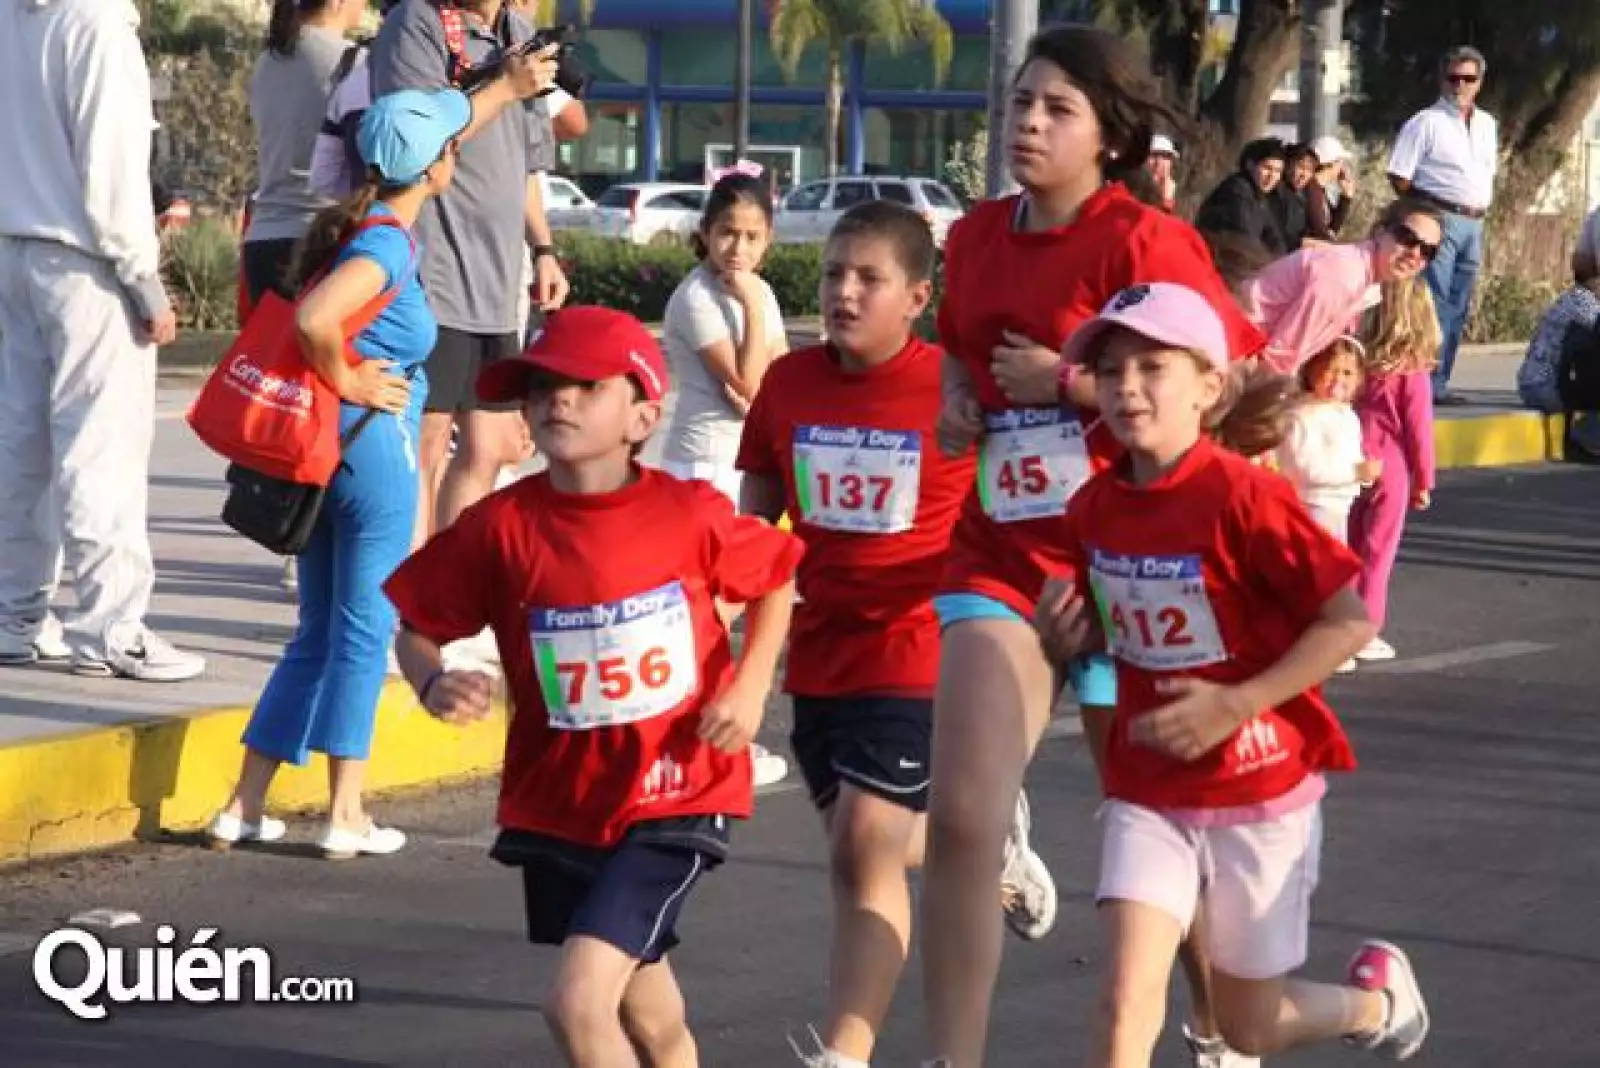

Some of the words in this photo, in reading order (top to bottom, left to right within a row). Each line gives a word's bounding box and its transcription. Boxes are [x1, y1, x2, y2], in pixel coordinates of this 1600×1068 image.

[1024, 407, 1059, 427] Day
[809, 426, 866, 449] Family
[869, 429, 906, 450] Day
[817, 472, 894, 512] 137
[998, 454, 1048, 498] 45
[1142, 558, 1184, 580] Day
[546, 603, 617, 628] Family
[622, 593, 669, 620] Day
[1111, 602, 1196, 647] 412
[555, 646, 672, 705] 756
